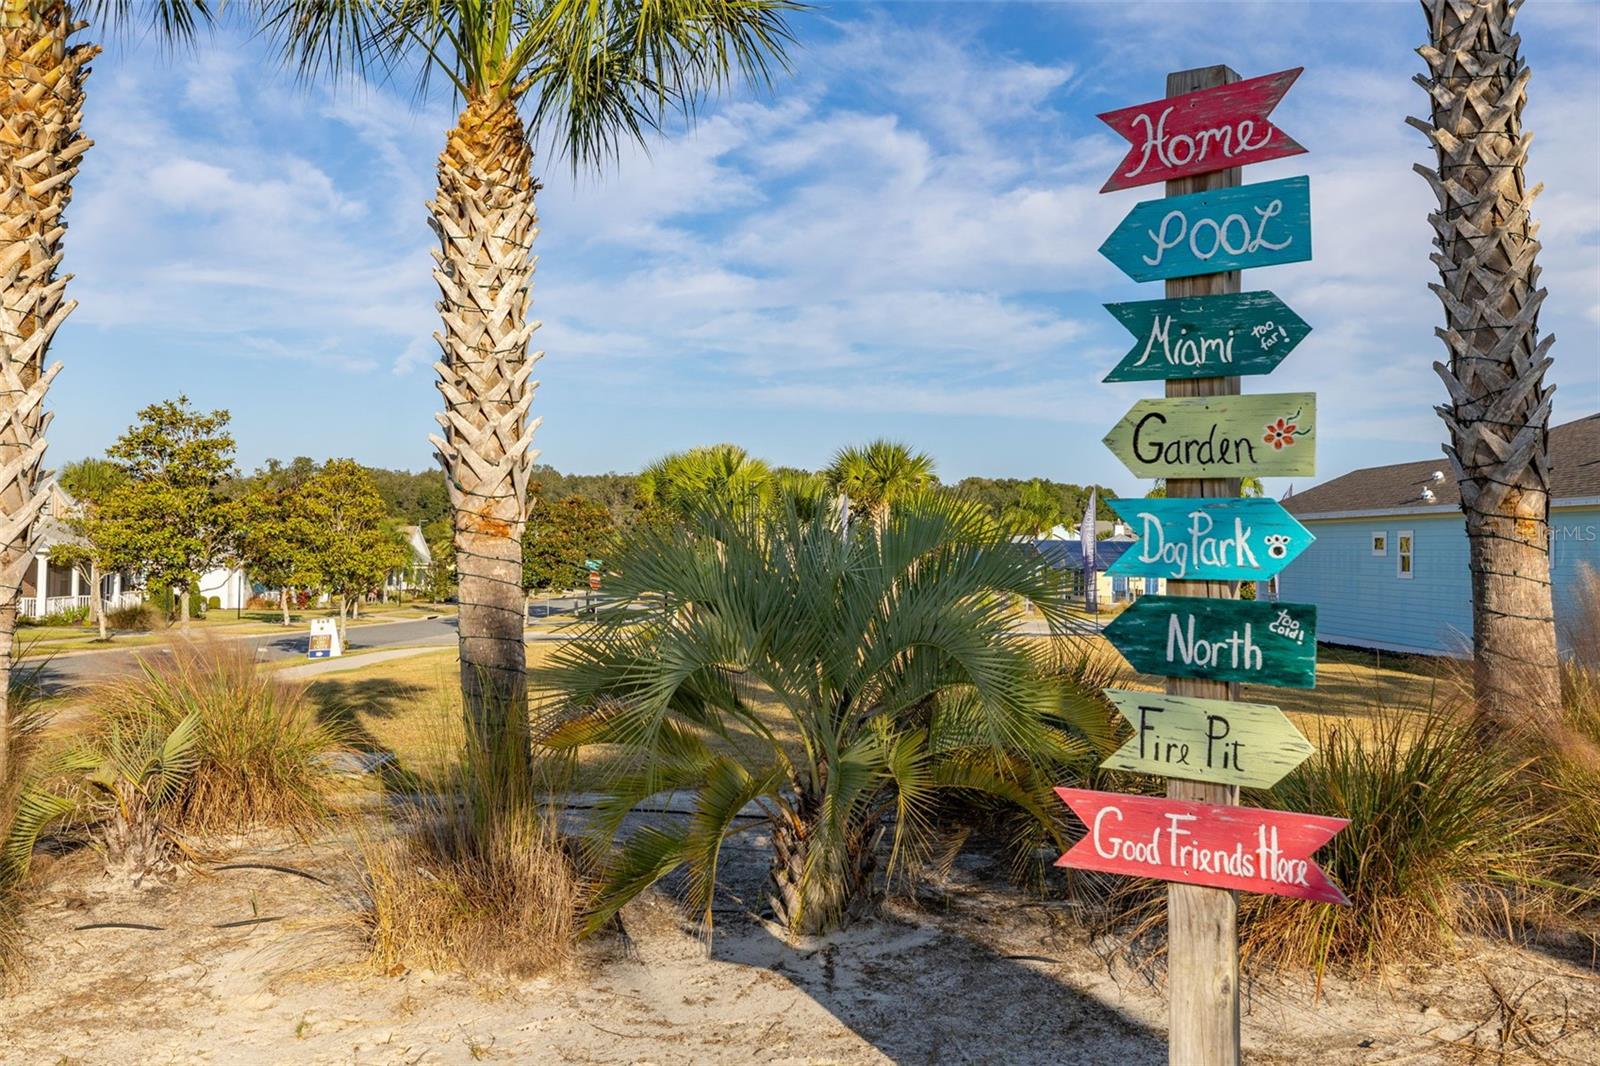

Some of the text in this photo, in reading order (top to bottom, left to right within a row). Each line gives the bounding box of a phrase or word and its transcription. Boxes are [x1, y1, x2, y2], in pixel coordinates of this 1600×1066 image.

[1125, 107, 1272, 178] Home
[1142, 199, 1292, 266] POOL
[1133, 315, 1234, 366] Miami
[1132, 412, 1258, 465] Garden
[1136, 512, 1188, 579] Dog
[1187, 511, 1260, 570] Park
[1166, 613, 1262, 670] North
[1138, 706, 1245, 772] Fire Pit
[1093, 806, 1310, 886] Good Friends Here
